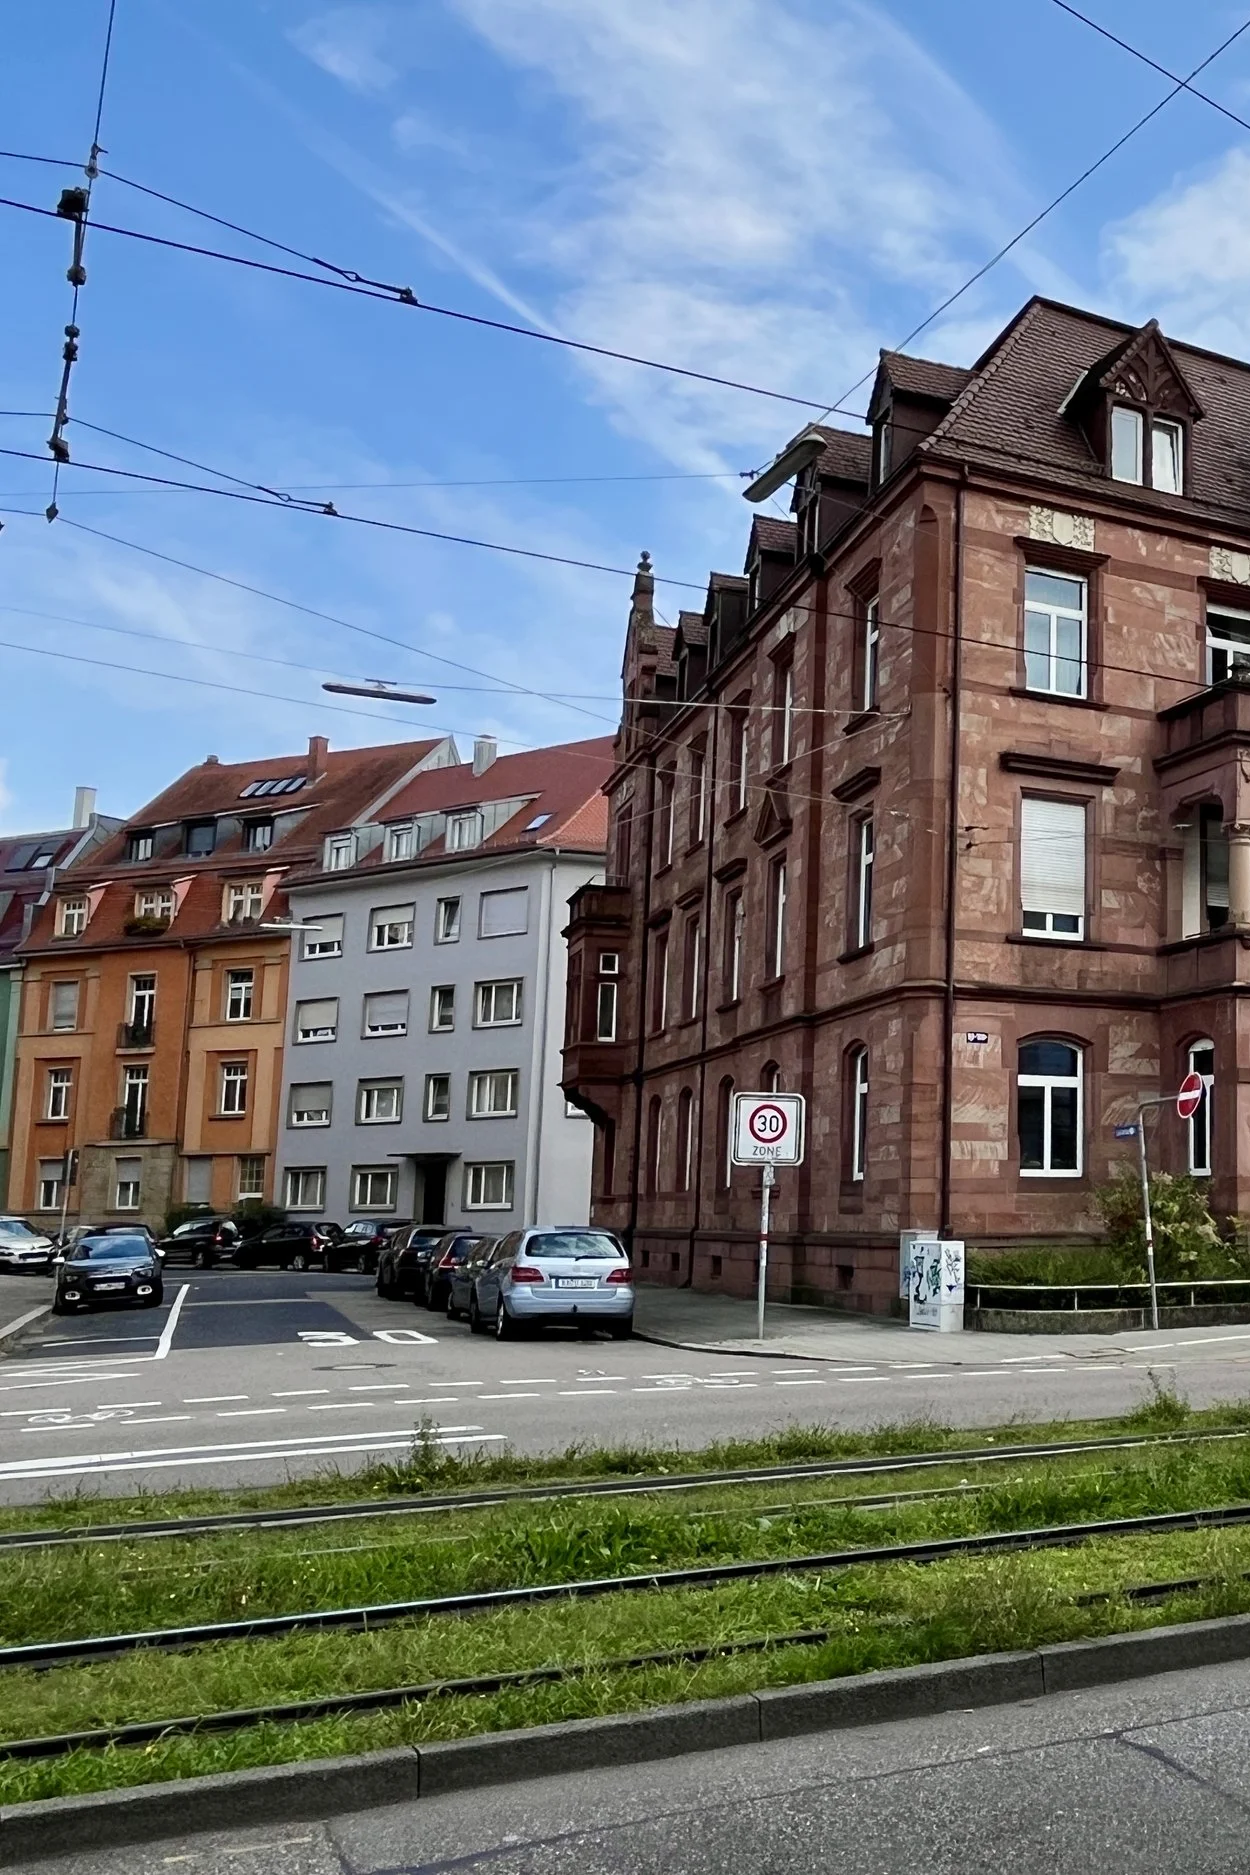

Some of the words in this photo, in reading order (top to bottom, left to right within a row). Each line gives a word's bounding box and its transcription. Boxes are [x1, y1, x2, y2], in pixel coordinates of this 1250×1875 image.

[757, 1114, 779, 1133] 30
[752, 1145, 781, 1157] ZONE
[297, 1329, 439, 1347] 30
